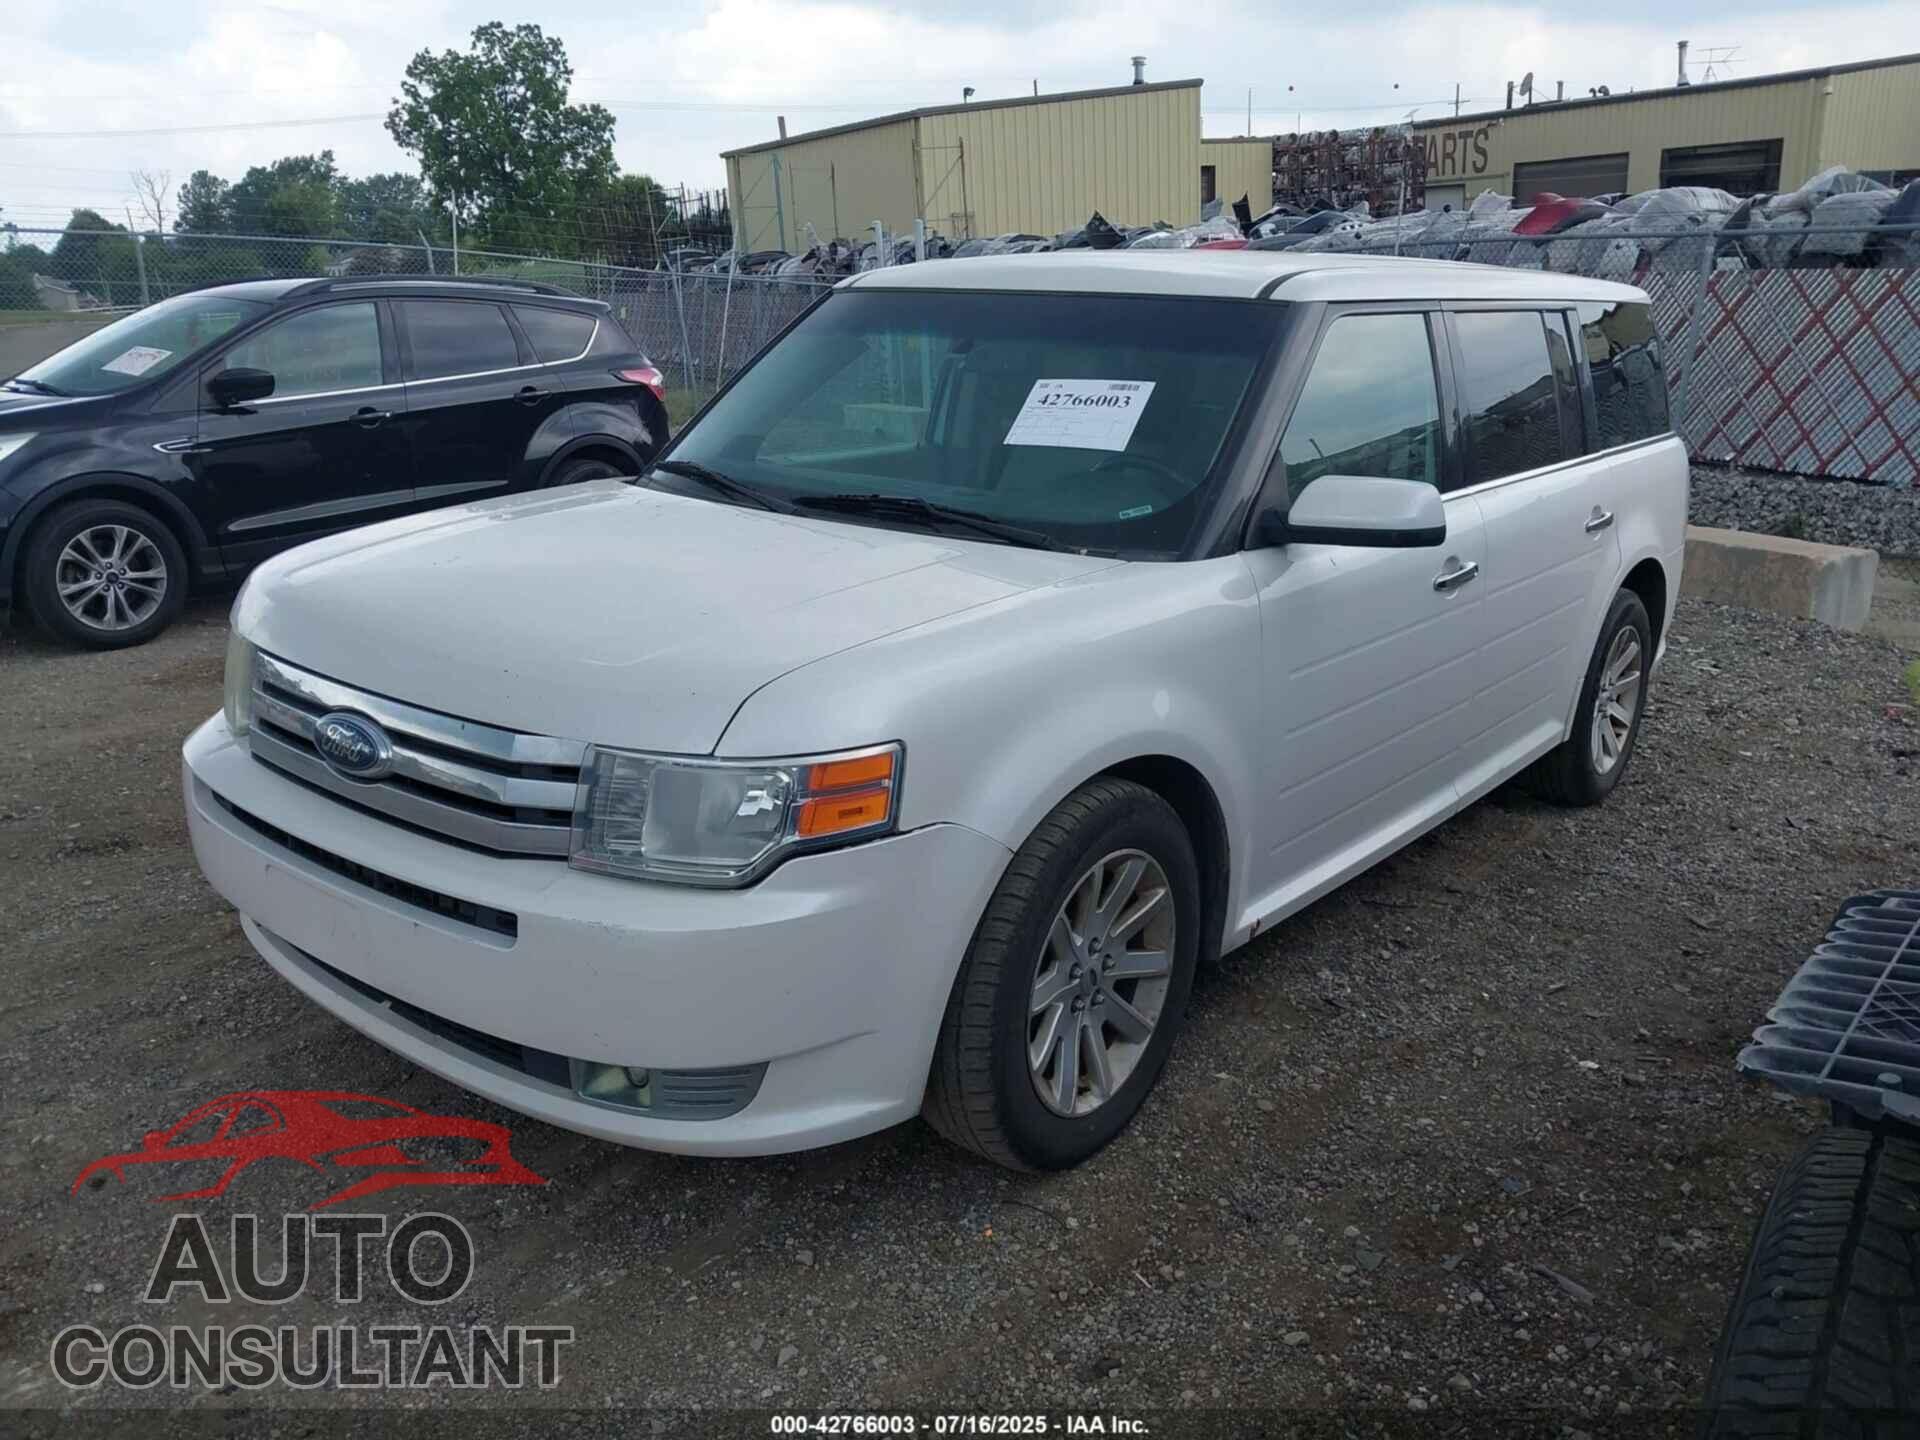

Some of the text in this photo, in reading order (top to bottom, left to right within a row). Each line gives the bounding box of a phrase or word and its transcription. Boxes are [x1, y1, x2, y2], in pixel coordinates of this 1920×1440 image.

[1423, 127, 1490, 177] ARTS
[1038, 393, 1132, 409] 42766003
[320, 723, 371, 763] Ford
